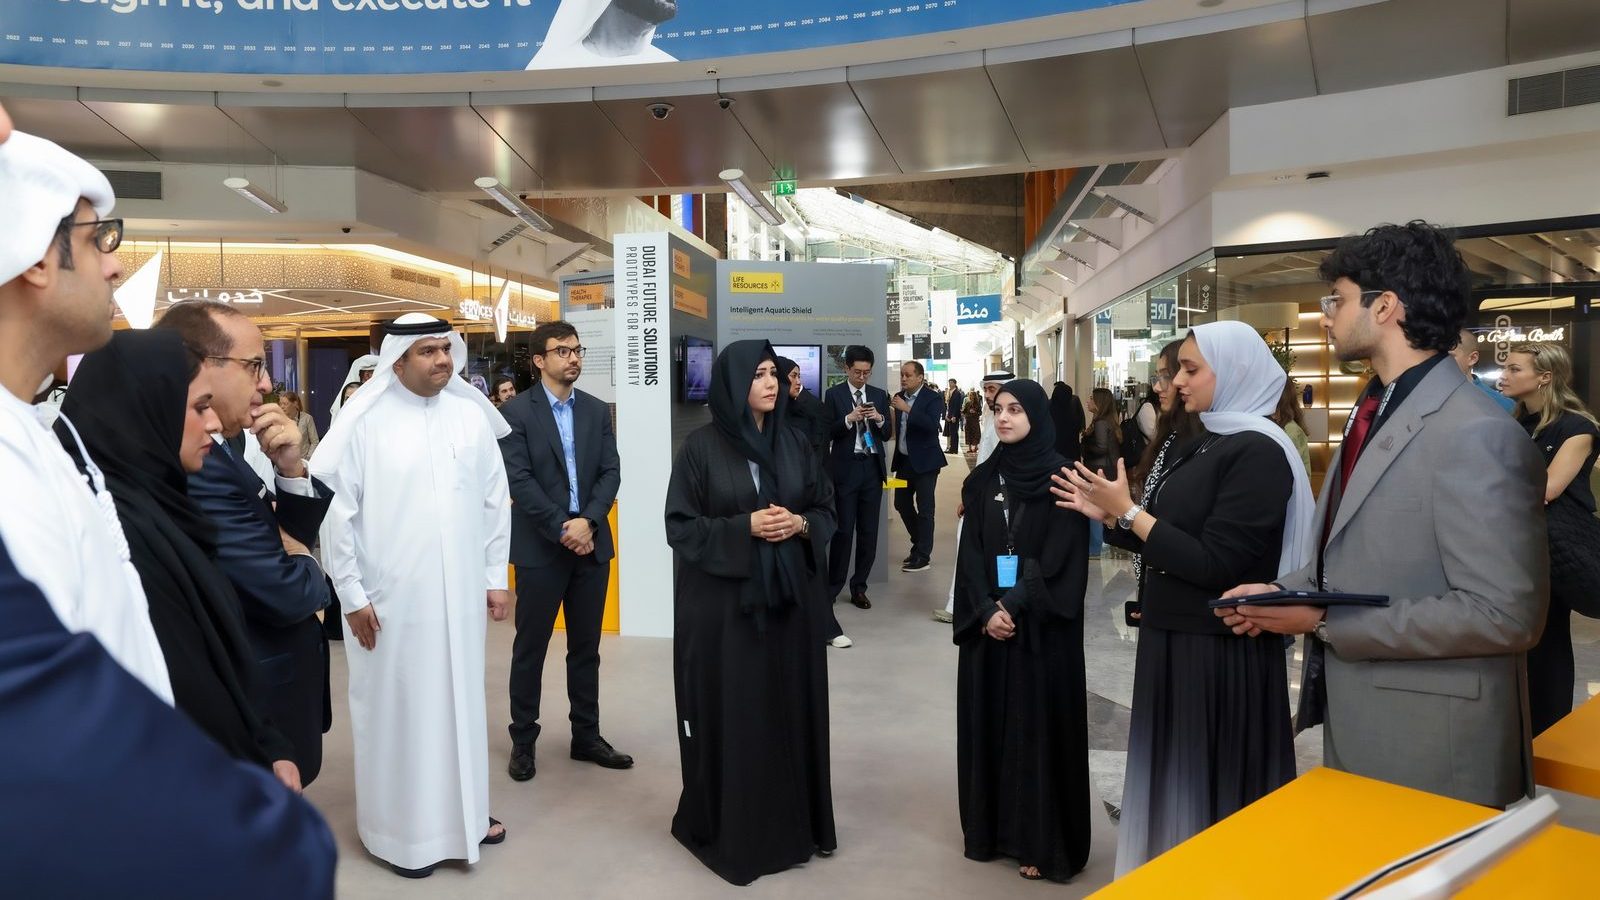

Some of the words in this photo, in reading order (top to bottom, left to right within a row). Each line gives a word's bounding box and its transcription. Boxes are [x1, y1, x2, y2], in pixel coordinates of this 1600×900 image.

[626, 246, 638, 307] PROTOTYPES
[642, 246, 656, 278] DUBAI
[459, 301, 493, 318] SERVICES
[643, 282, 657, 323] FUTURE
[730, 306, 764, 314] Intelligent
[765, 307, 791, 315] Aquatic
[627, 313, 639, 330] FOR
[1528, 327, 1564, 342] Booth
[643, 328, 658, 386] SOLUTIONS
[1497, 318, 1508, 362] GOD
[627, 336, 639, 386] HUMANITY
